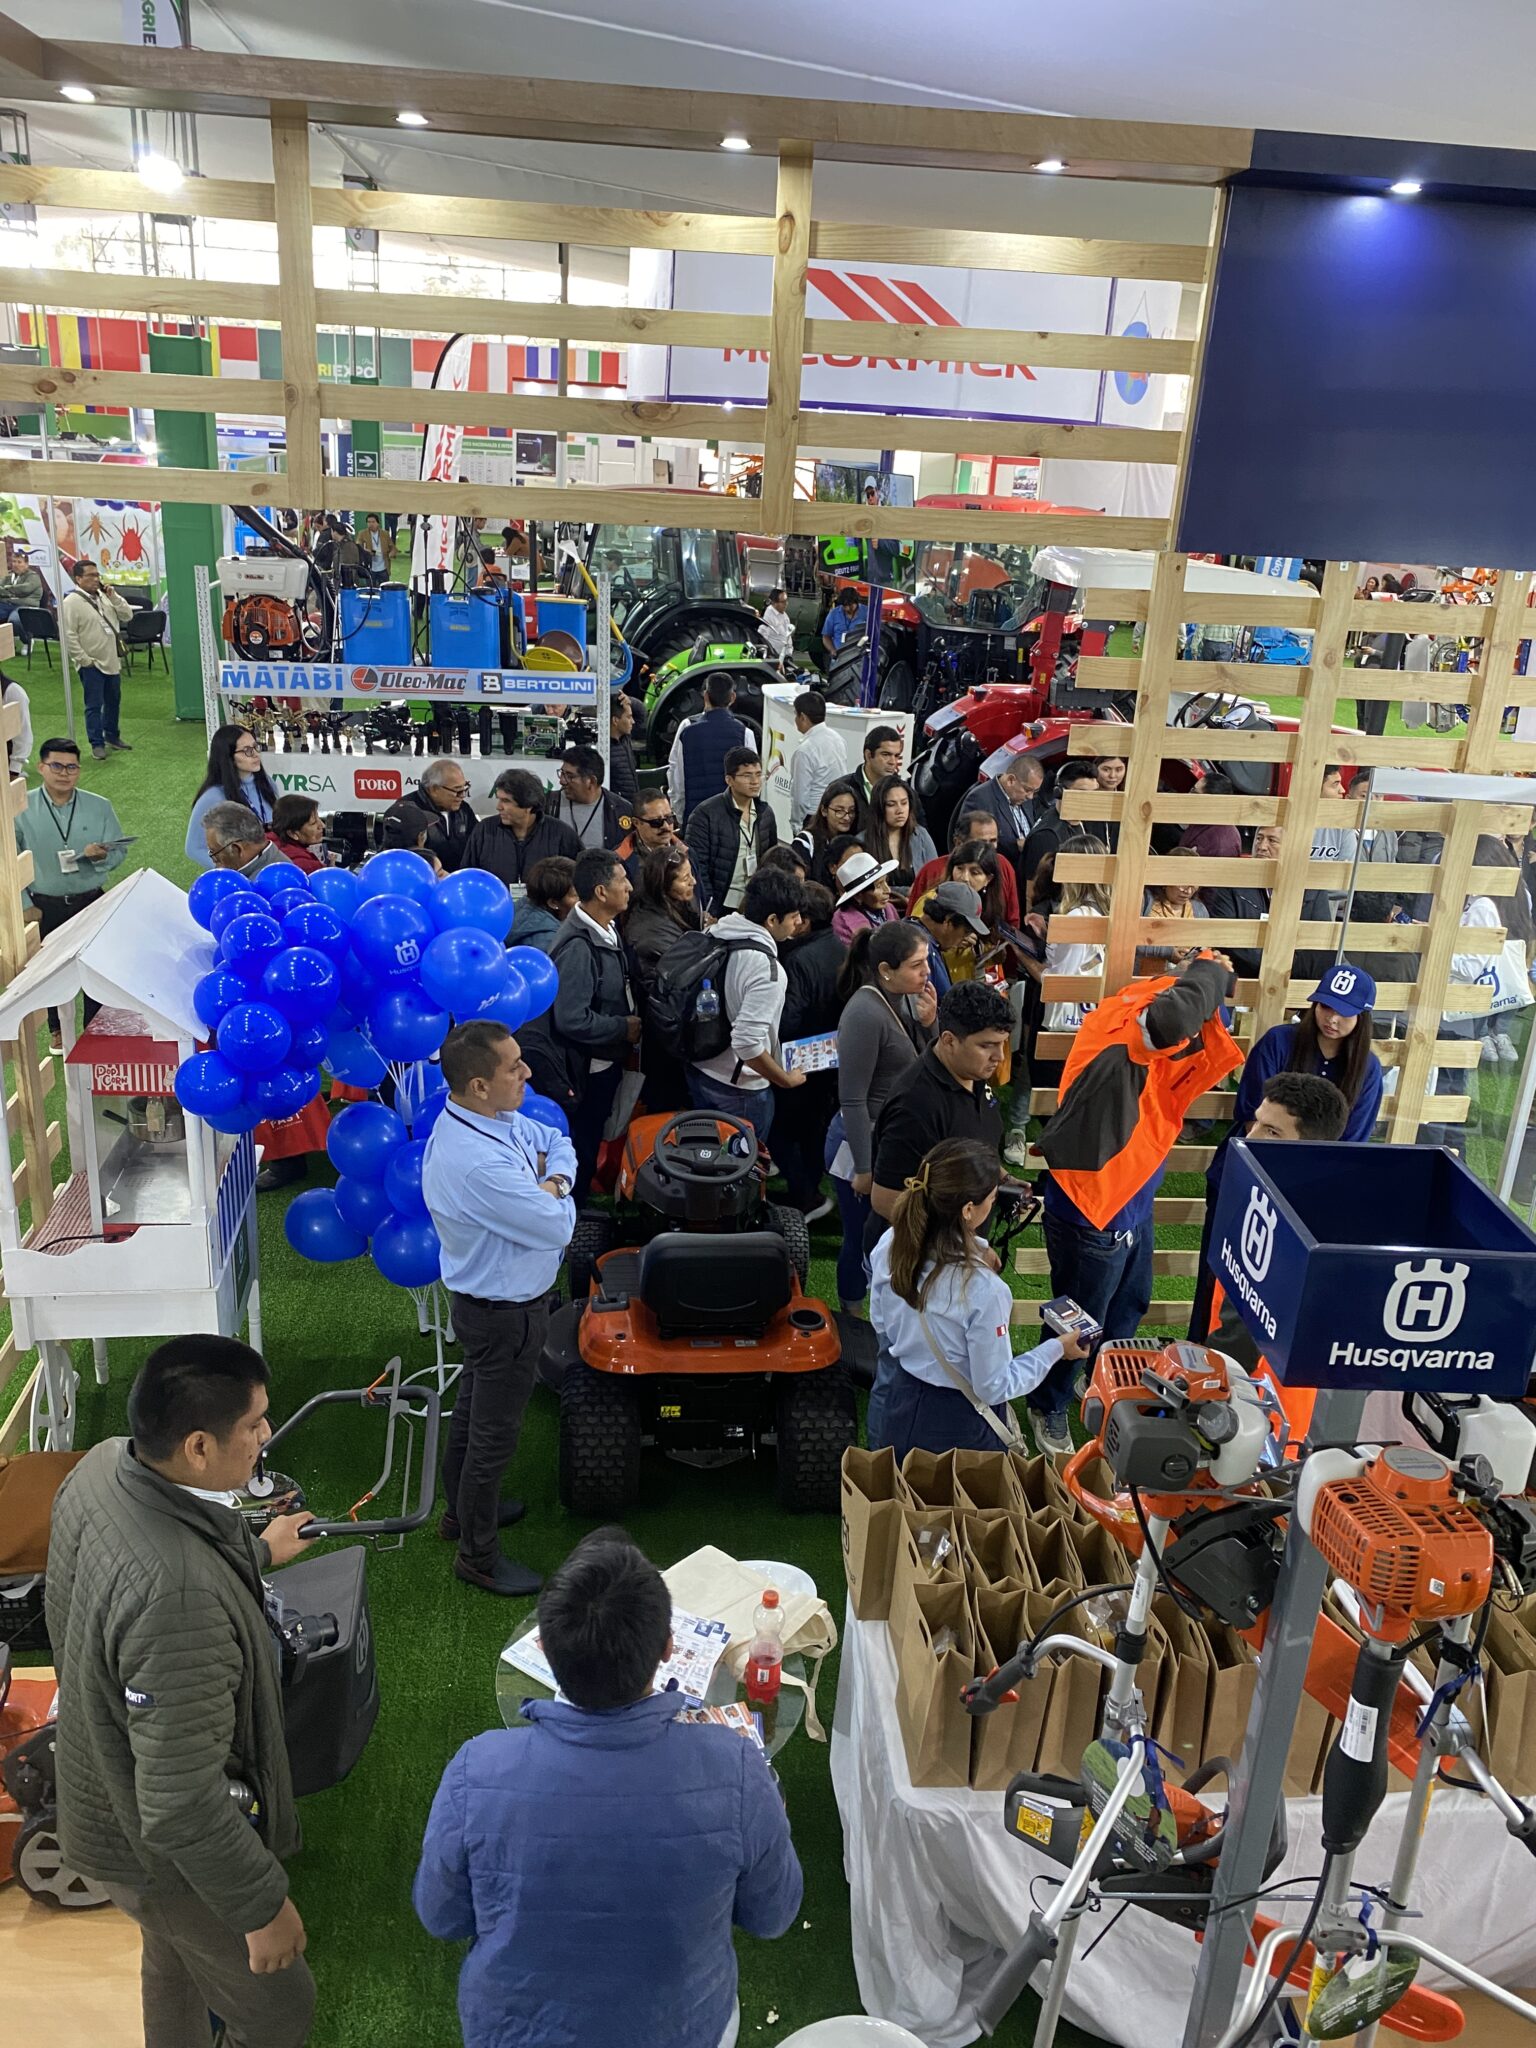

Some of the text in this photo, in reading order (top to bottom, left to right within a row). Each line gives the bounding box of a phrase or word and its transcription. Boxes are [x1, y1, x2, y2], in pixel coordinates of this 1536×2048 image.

[380, 672, 467, 690] Oleo-Mac
[504, 678, 592, 692] BERTOLINI
[272, 773, 337, 793] YRSA
[357, 778, 397, 791] TORO
[1220, 1237, 1277, 1341] Husqvarna
[1328, 1341, 1495, 1372] Husqvarna
